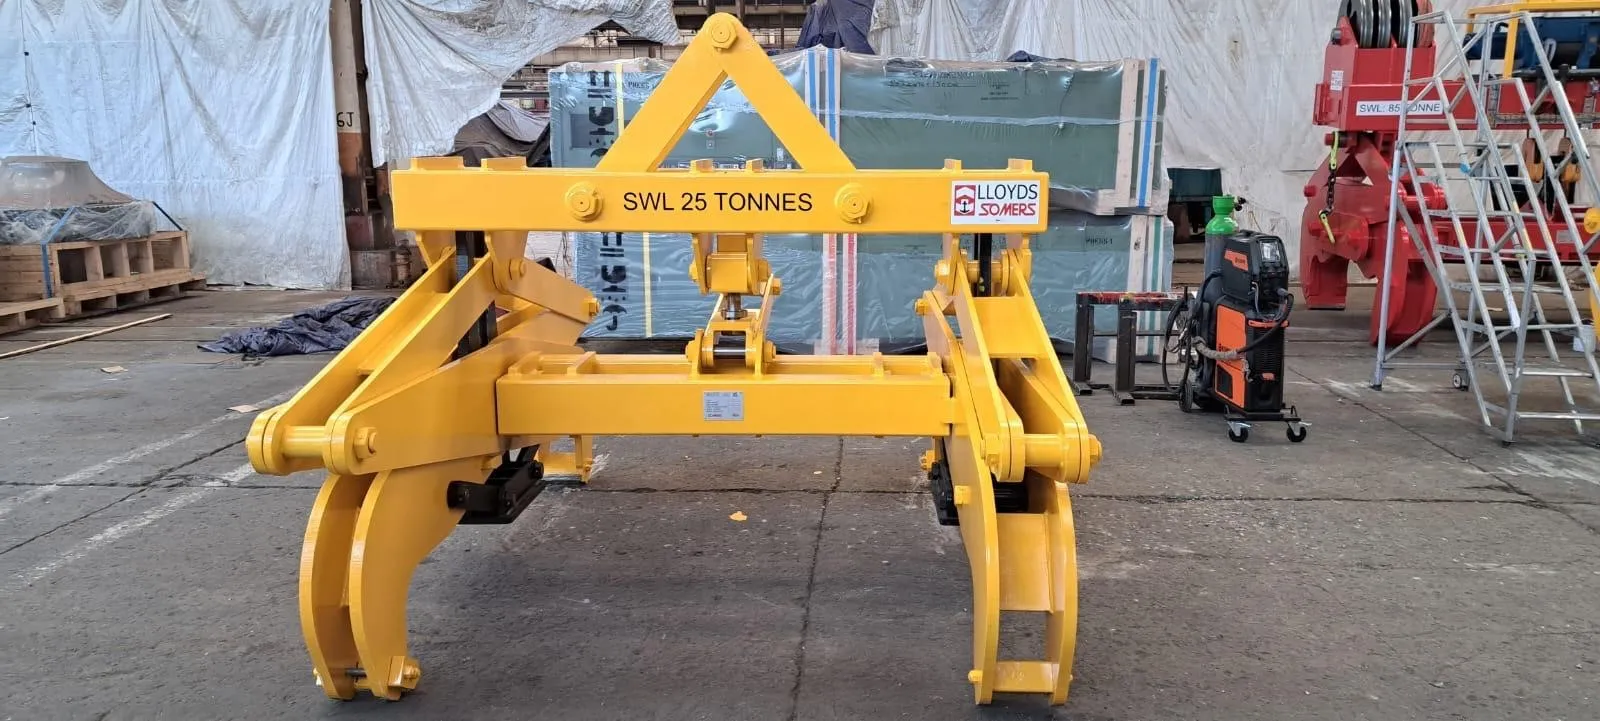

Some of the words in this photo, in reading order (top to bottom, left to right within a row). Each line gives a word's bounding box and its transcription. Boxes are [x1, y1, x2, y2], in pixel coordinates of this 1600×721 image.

[1388, 104, 1400, 112] 85
[337, 111, 354, 127] 6J
[978, 184, 1037, 199] LLOYDS
[623, 192, 674, 211] SWL
[681, 192, 707, 211] 25
[714, 192, 813, 211] TONNES
[979, 203, 1036, 216] SOMERS
